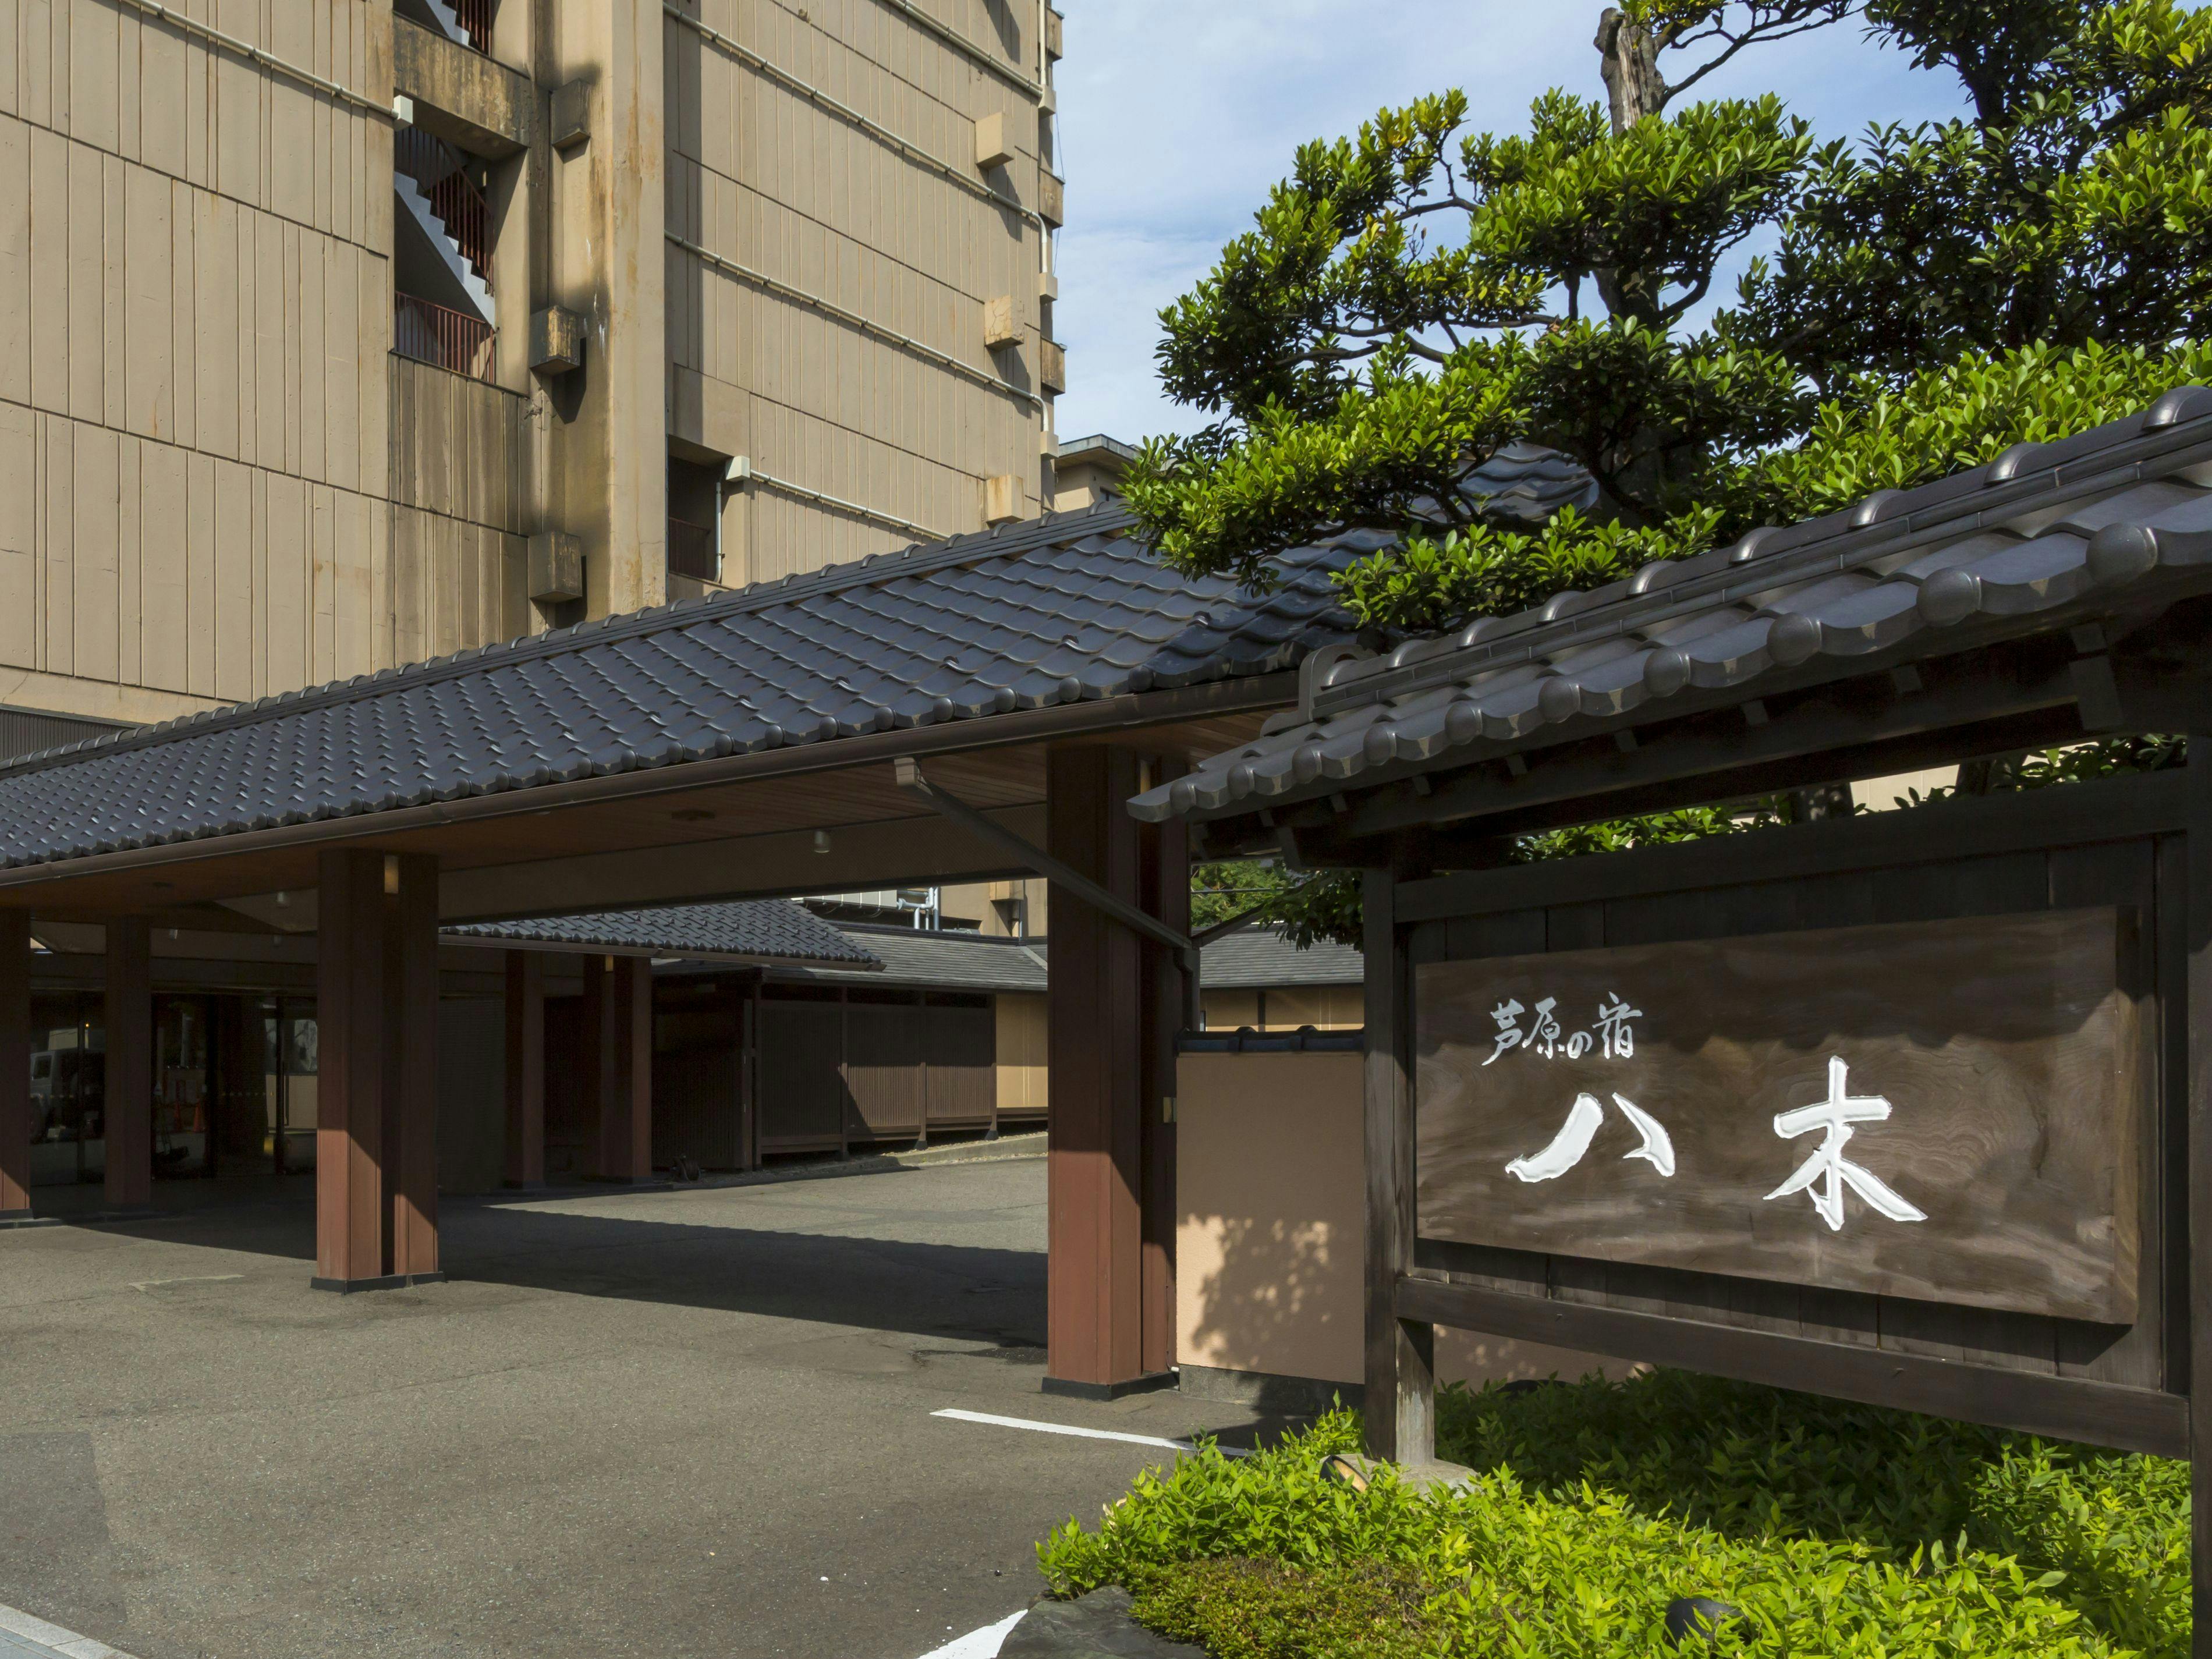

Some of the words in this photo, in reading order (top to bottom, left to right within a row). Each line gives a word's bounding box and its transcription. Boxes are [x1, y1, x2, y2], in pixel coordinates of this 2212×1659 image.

[1481, 991, 1643, 1066] 芦原の宿
[1505, 1055, 1928, 1232] 八木
